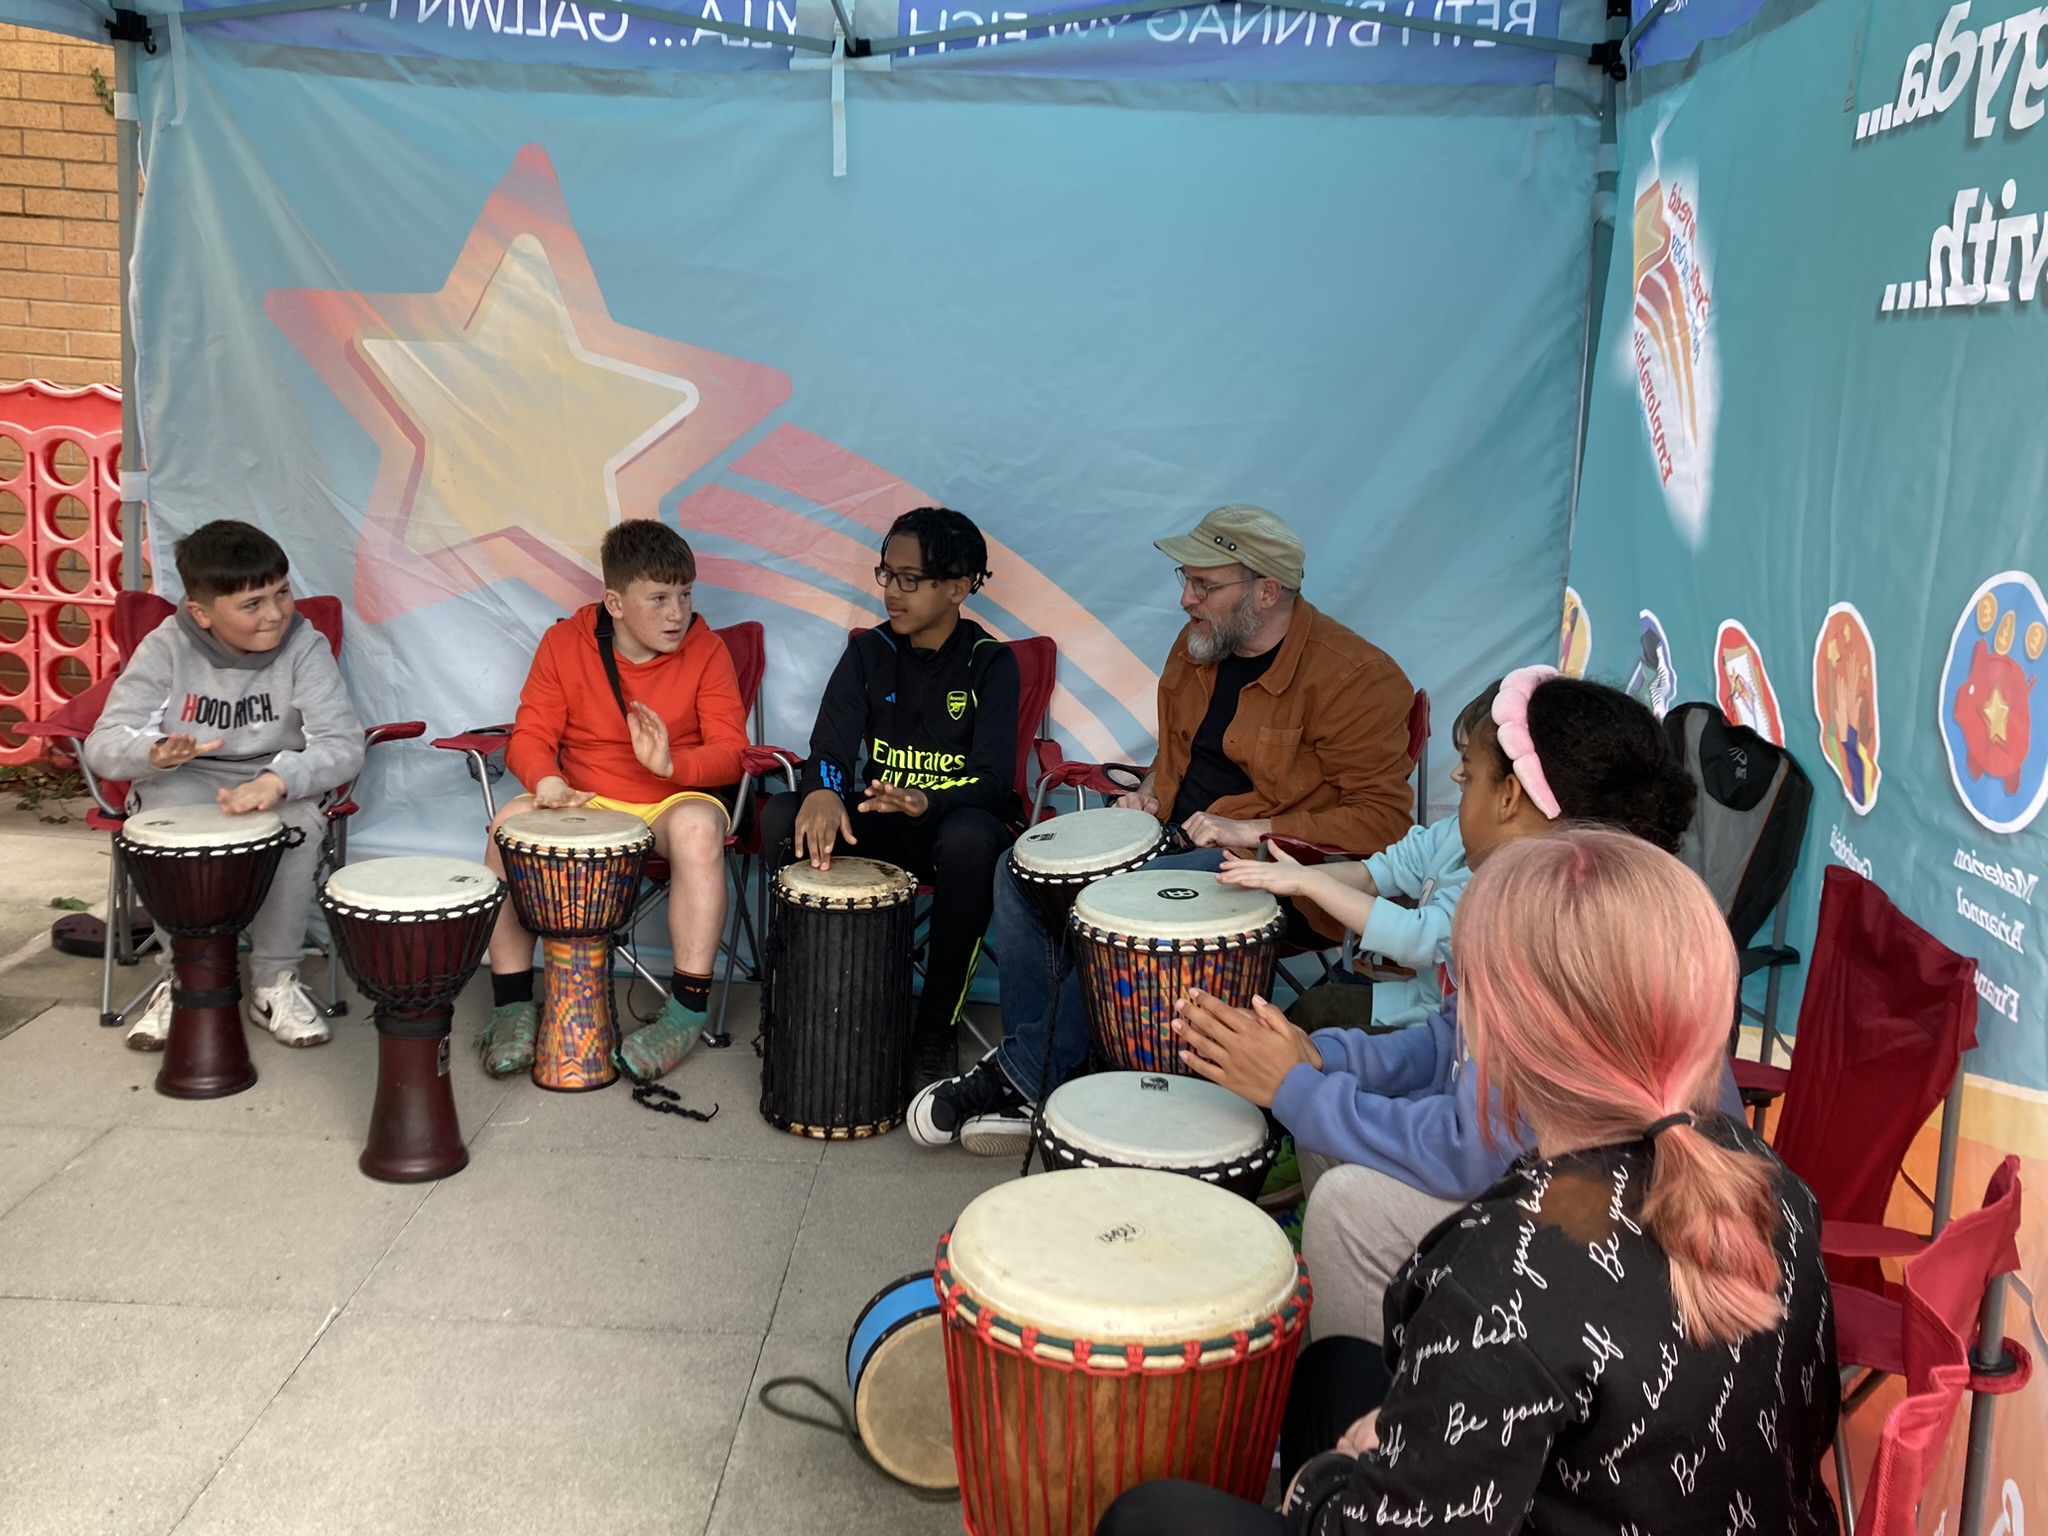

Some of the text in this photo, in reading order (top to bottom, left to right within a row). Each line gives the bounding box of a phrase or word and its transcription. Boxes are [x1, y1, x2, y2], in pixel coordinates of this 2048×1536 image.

[872, 737, 966, 773] Emirates
[1588, 1164, 1642, 1283] Be your
[1512, 1219, 1548, 1290] your
[1800, 1359, 1817, 1408] Be
[1444, 1402, 1488, 1446] Be
[1501, 1397, 1564, 1447] your
[1556, 1457, 1591, 1494] Be
[1599, 1416, 1646, 1485] your
[1642, 1341, 1679, 1411] best
[1670, 1445, 1706, 1497] Be
[1707, 1371, 1735, 1452] your
[1756, 1400, 1778, 1454] Be
[1375, 1493, 1434, 1529] best
[1443, 1479, 1503, 1524] self
